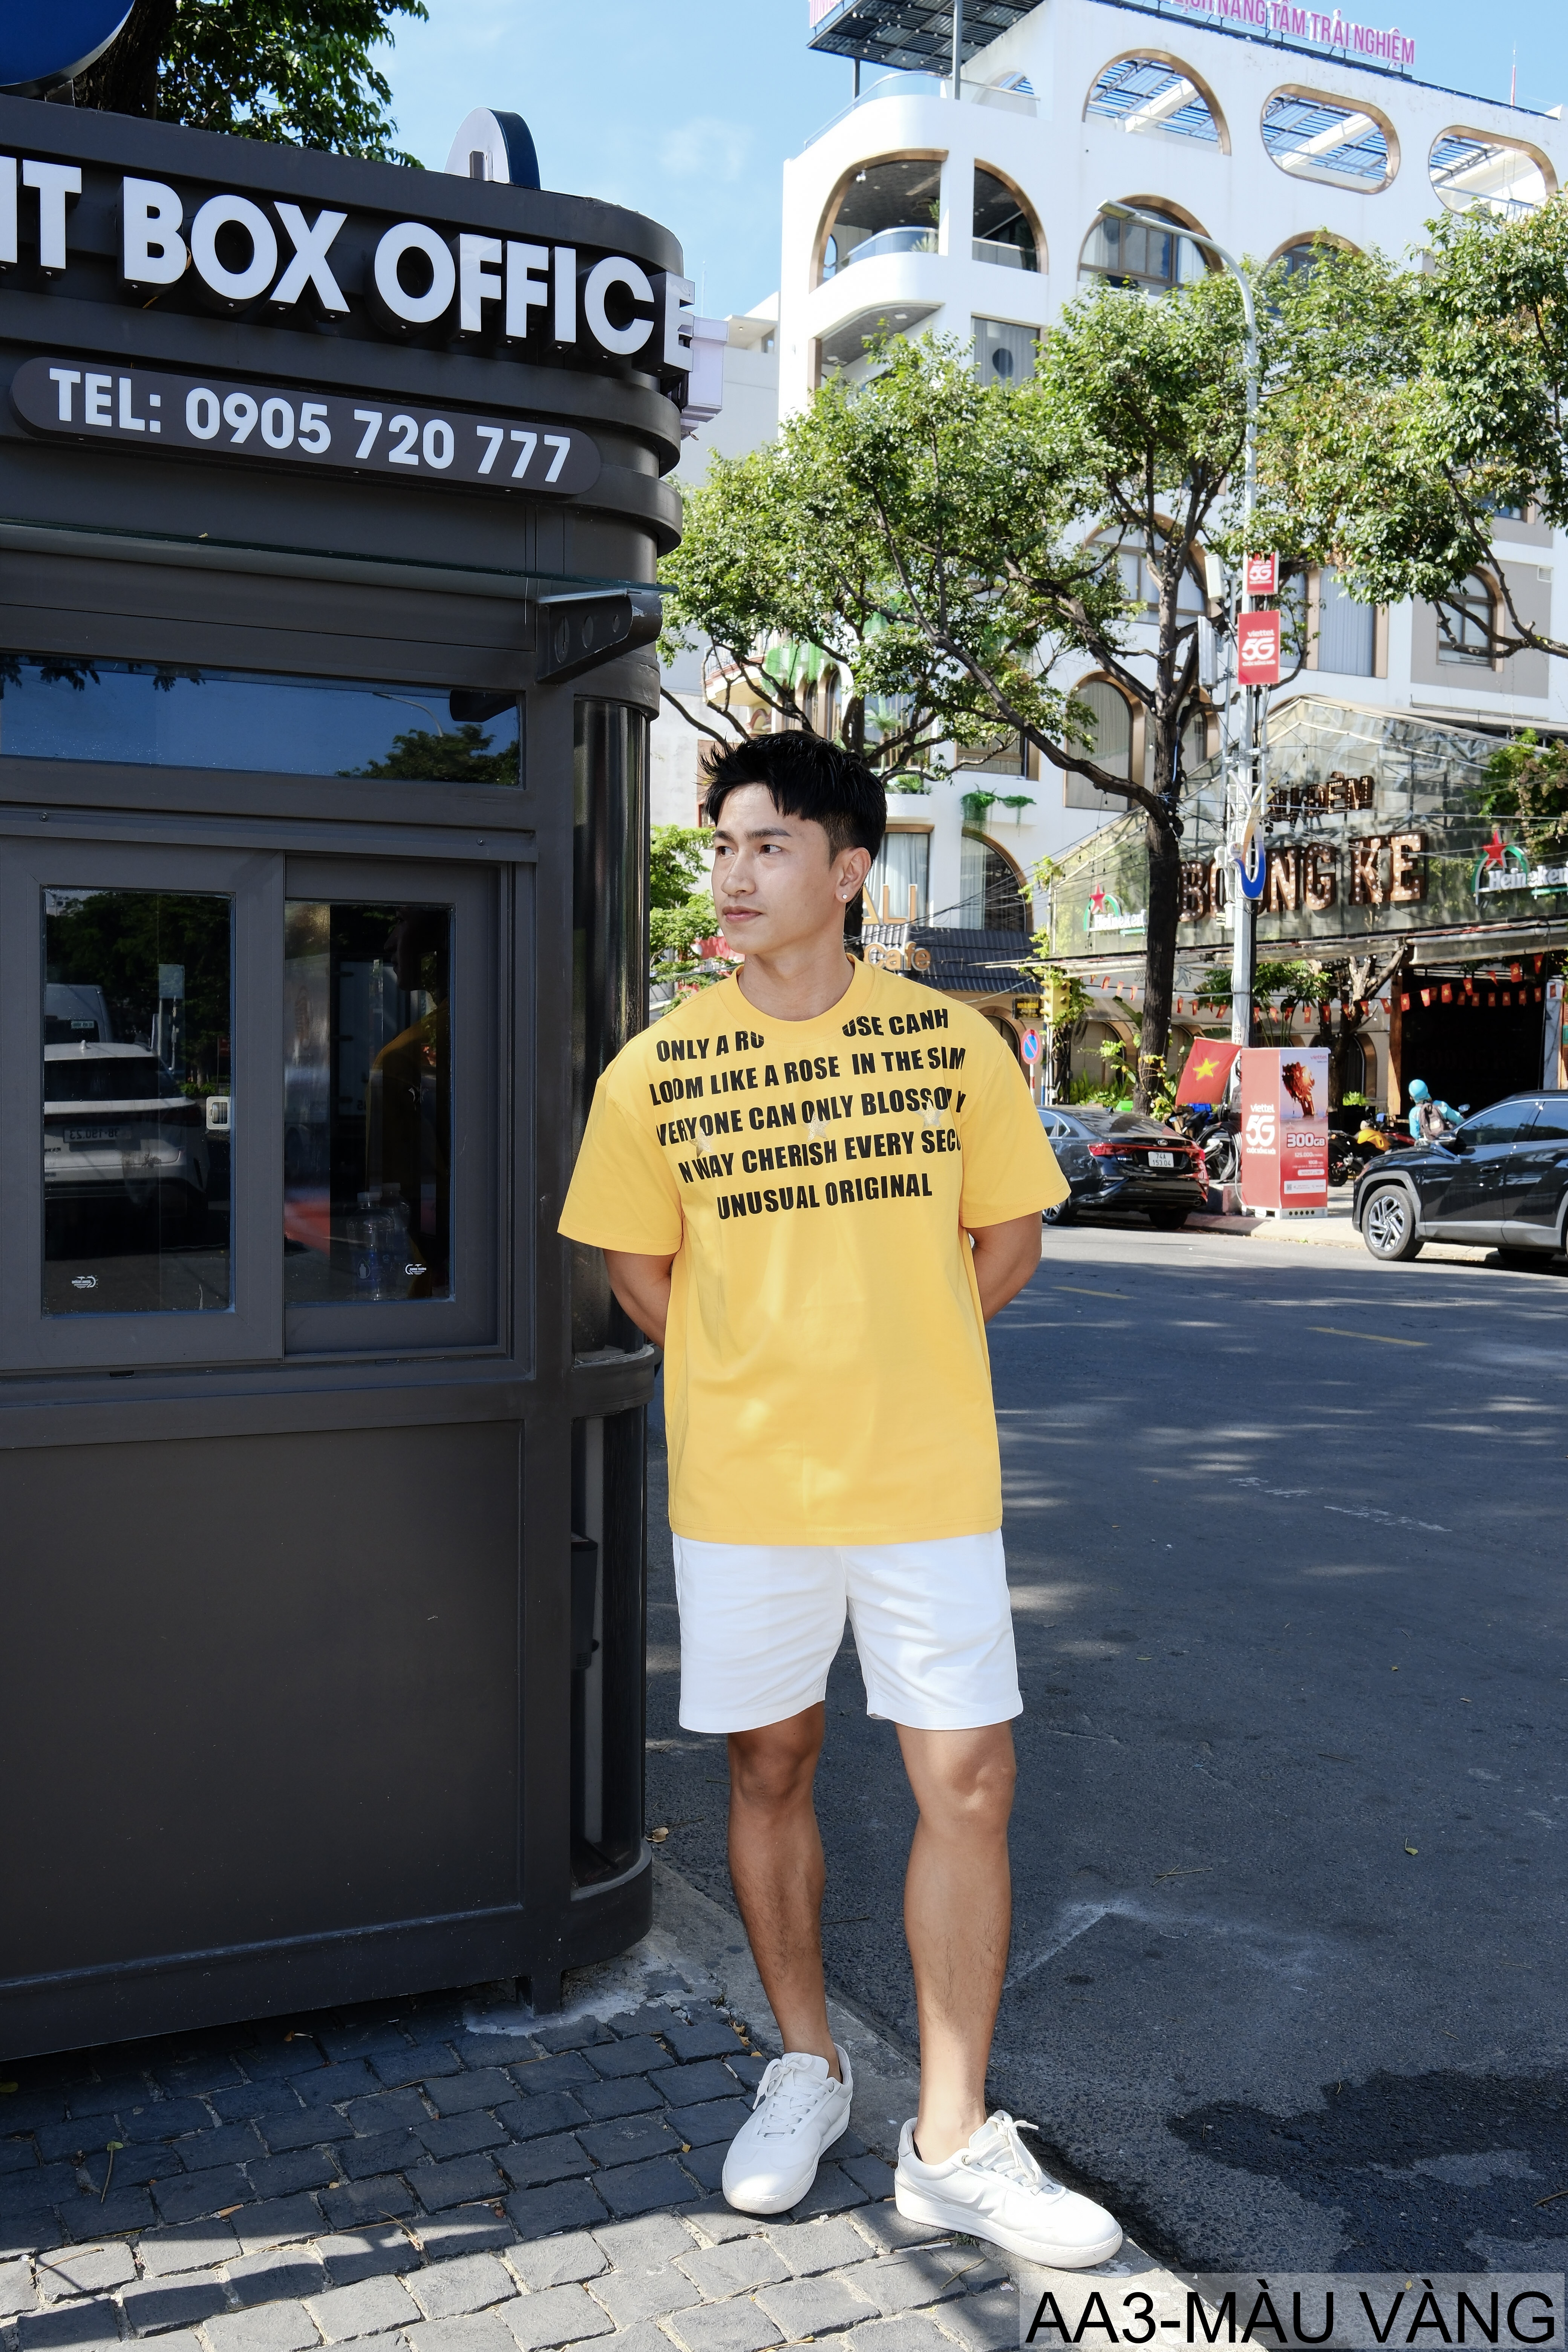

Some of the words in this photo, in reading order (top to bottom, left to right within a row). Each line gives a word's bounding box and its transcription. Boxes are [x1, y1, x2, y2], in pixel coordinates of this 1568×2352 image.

[1311, 9, 1350, 47] TRẢI
[1355, 24, 1415, 66] NGHIỆM
[122, 176, 351, 314] BOX
[376, 222, 695, 372] OFFICE
[49, 368, 161, 434] TEL:
[186, 387, 331, 454] 0905
[353, 409, 455, 470] 720
[476, 426, 571, 483] 777
[1249, 565, 1272, 580] 5G
[1242, 637, 1275, 660] 5G
[1349, 833, 1429, 906] KE
[1094, 914, 1144, 929] Heineken
[656, 1038, 709, 1062] ONLY
[716, 1035, 729, 1056] A
[888, 1008, 948, 1035] CANH
[649, 1076, 703, 1106] LOOM
[710, 1067, 758, 1095] LIKE
[765, 1065, 779, 1087] A
[784, 1056, 840, 1084] ROSE
[852, 1053, 876, 1075] IN
[881, 1049, 924, 1072] THE
[656, 1109, 743, 1146] VERYONE
[749, 1102, 796, 1130] CAN
[801, 1095, 853, 1123] ONLY
[1246, 1115, 1275, 1147] 5G
[1250, 1103, 1275, 1113] viettel
[678, 1161, 694, 1183] N
[691, 1152, 734, 1180] WAY
[742, 1139, 837, 1173] CHERISH
[844, 1131, 914, 1160] EVERY
[1287, 1133, 1326, 1148] 300GB
[717, 1185, 820, 1220] UNUSUAL
[825, 1173, 933, 1206] ORIGINAL
